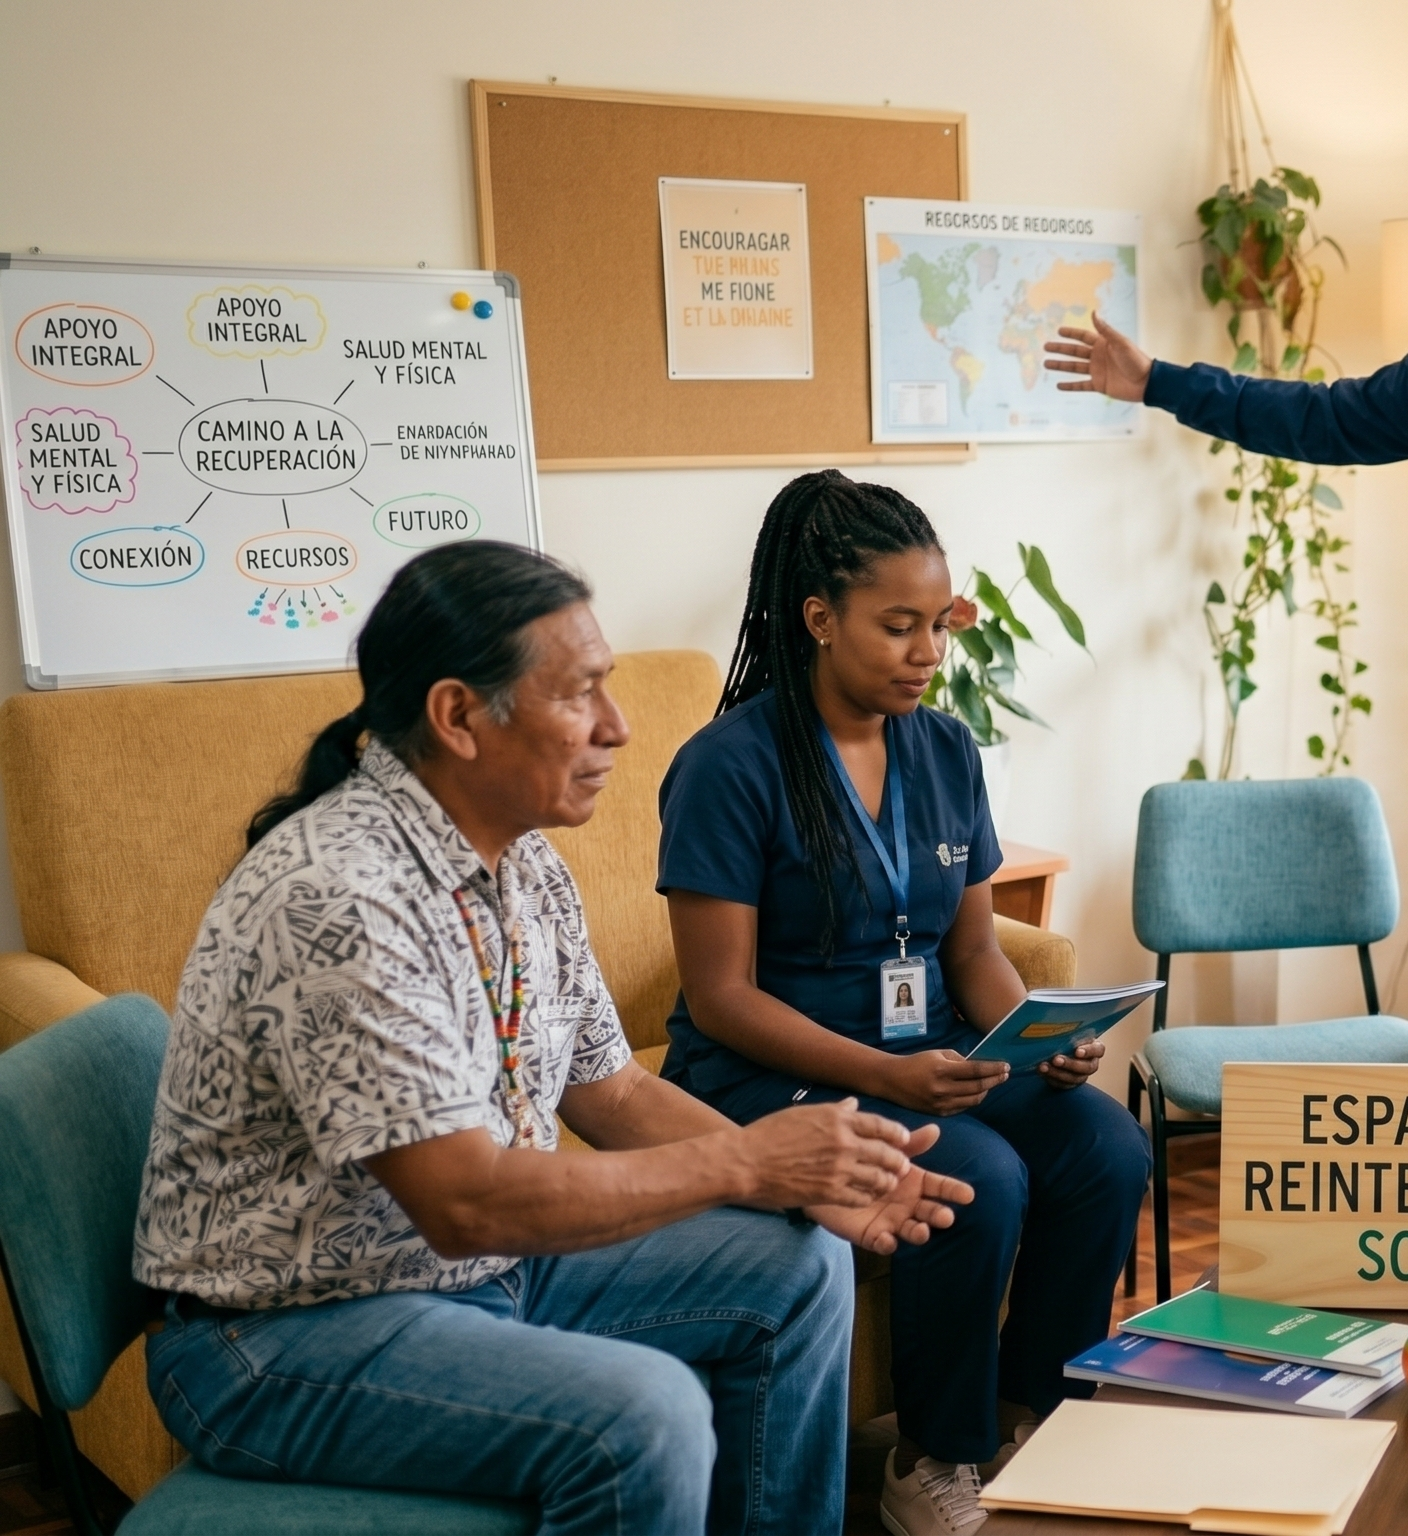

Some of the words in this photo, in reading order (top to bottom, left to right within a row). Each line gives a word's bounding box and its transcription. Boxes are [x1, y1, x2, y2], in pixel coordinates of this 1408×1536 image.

[1002, 216, 1018, 231] DE
[679, 230, 791, 251] ENCOURAGAR
[701, 282, 724, 300] ME
[730, 282, 775, 301] FIONE
[216, 298, 282, 318] APOYO
[683, 307, 702, 326] ET
[44, 319, 118, 340] APOYO
[207, 322, 307, 343] INTEGRAL
[31, 345, 142, 367] INTEGRAL
[343, 339, 405, 359] SALUD
[412, 341, 487, 360] MENTAL
[375, 366, 387, 384] Y
[396, 363, 456, 385] FÍSICA
[31, 423, 101, 443] SALUD
[198, 421, 285, 441] CAMINO
[293, 420, 309, 441] A
[317, 420, 344, 441] LA
[397, 421, 488, 439] ENARDACIÓN
[29, 448, 117, 468] MENTAL
[196, 445, 356, 471] RECUPERACIÓN
[400, 445, 420, 460] DE
[31, 475, 45, 494] Y
[53, 471, 121, 494] FÍSICA
[388, 510, 468, 531] FUTURO
[79, 540, 192, 570] CONEXIÓN
[246, 547, 349, 570] RECURSOS
